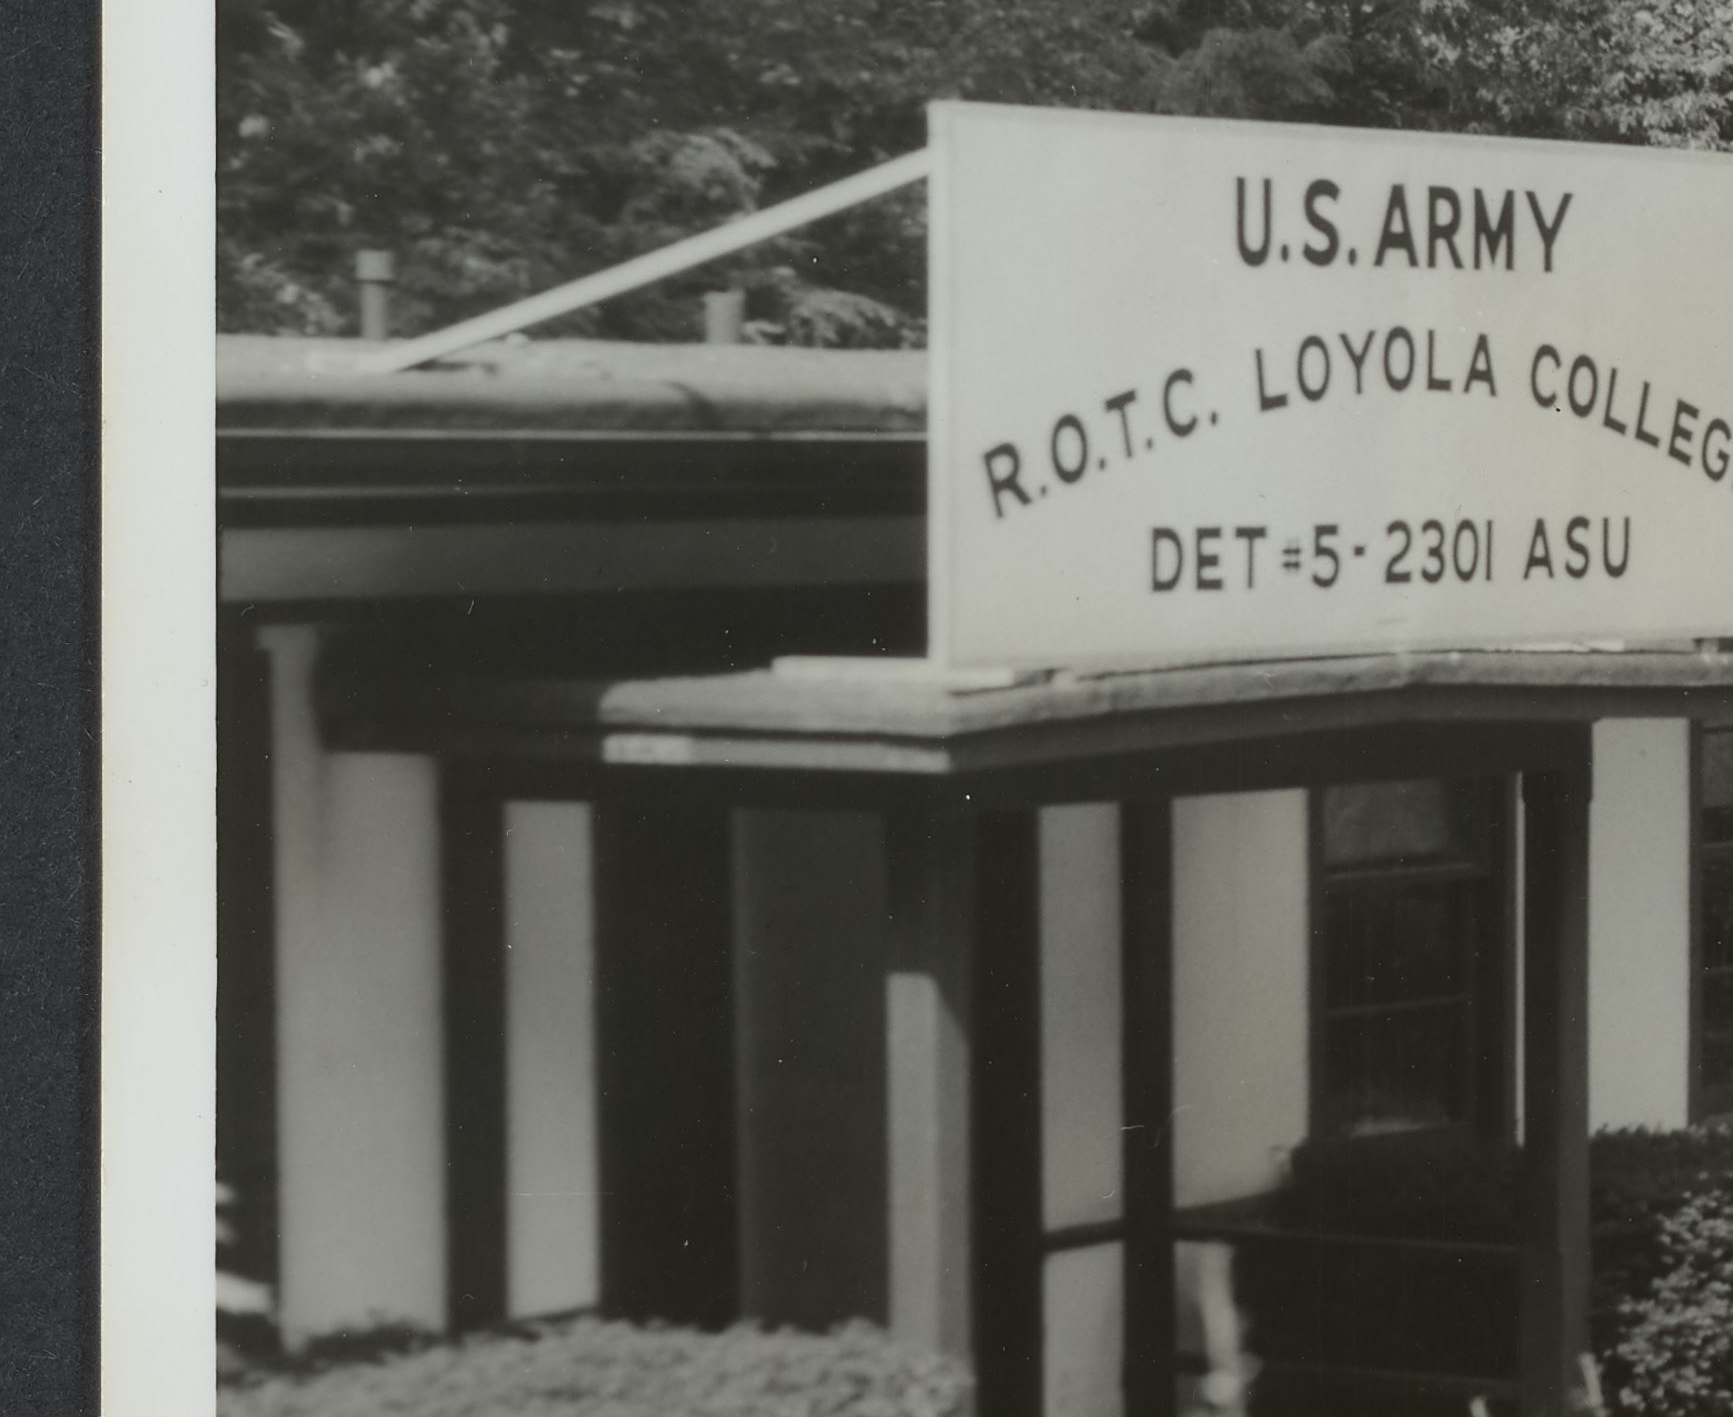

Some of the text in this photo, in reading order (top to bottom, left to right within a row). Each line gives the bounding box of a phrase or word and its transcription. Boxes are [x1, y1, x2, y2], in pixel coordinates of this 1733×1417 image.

[982, 367, 1220, 520] R.O.T.C.
[1254, 324, 1498, 413] LOYOLA
[1521, 515, 1632, 582] ASU
